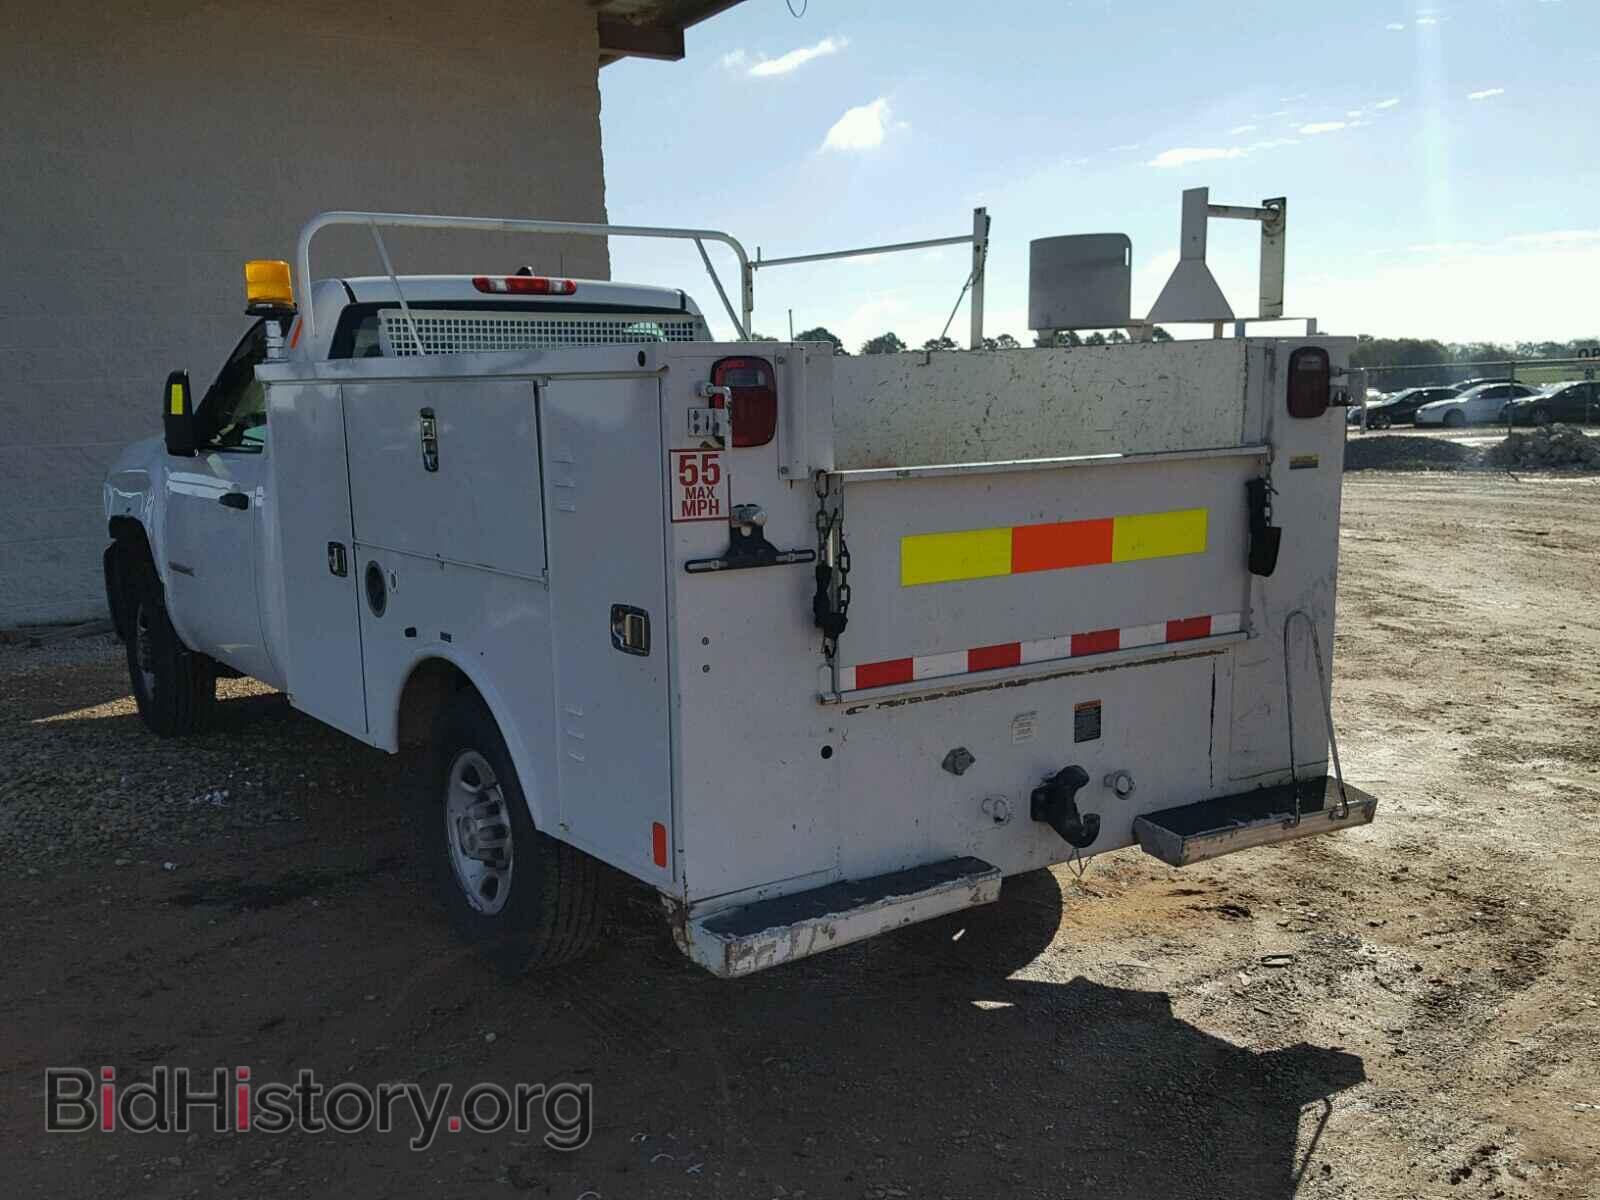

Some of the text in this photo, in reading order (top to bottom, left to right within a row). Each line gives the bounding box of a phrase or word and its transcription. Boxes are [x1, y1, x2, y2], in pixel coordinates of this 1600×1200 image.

[679, 454, 720, 486] 55
[685, 486, 715, 500] MAX
[681, 499, 720, 517] MPH
